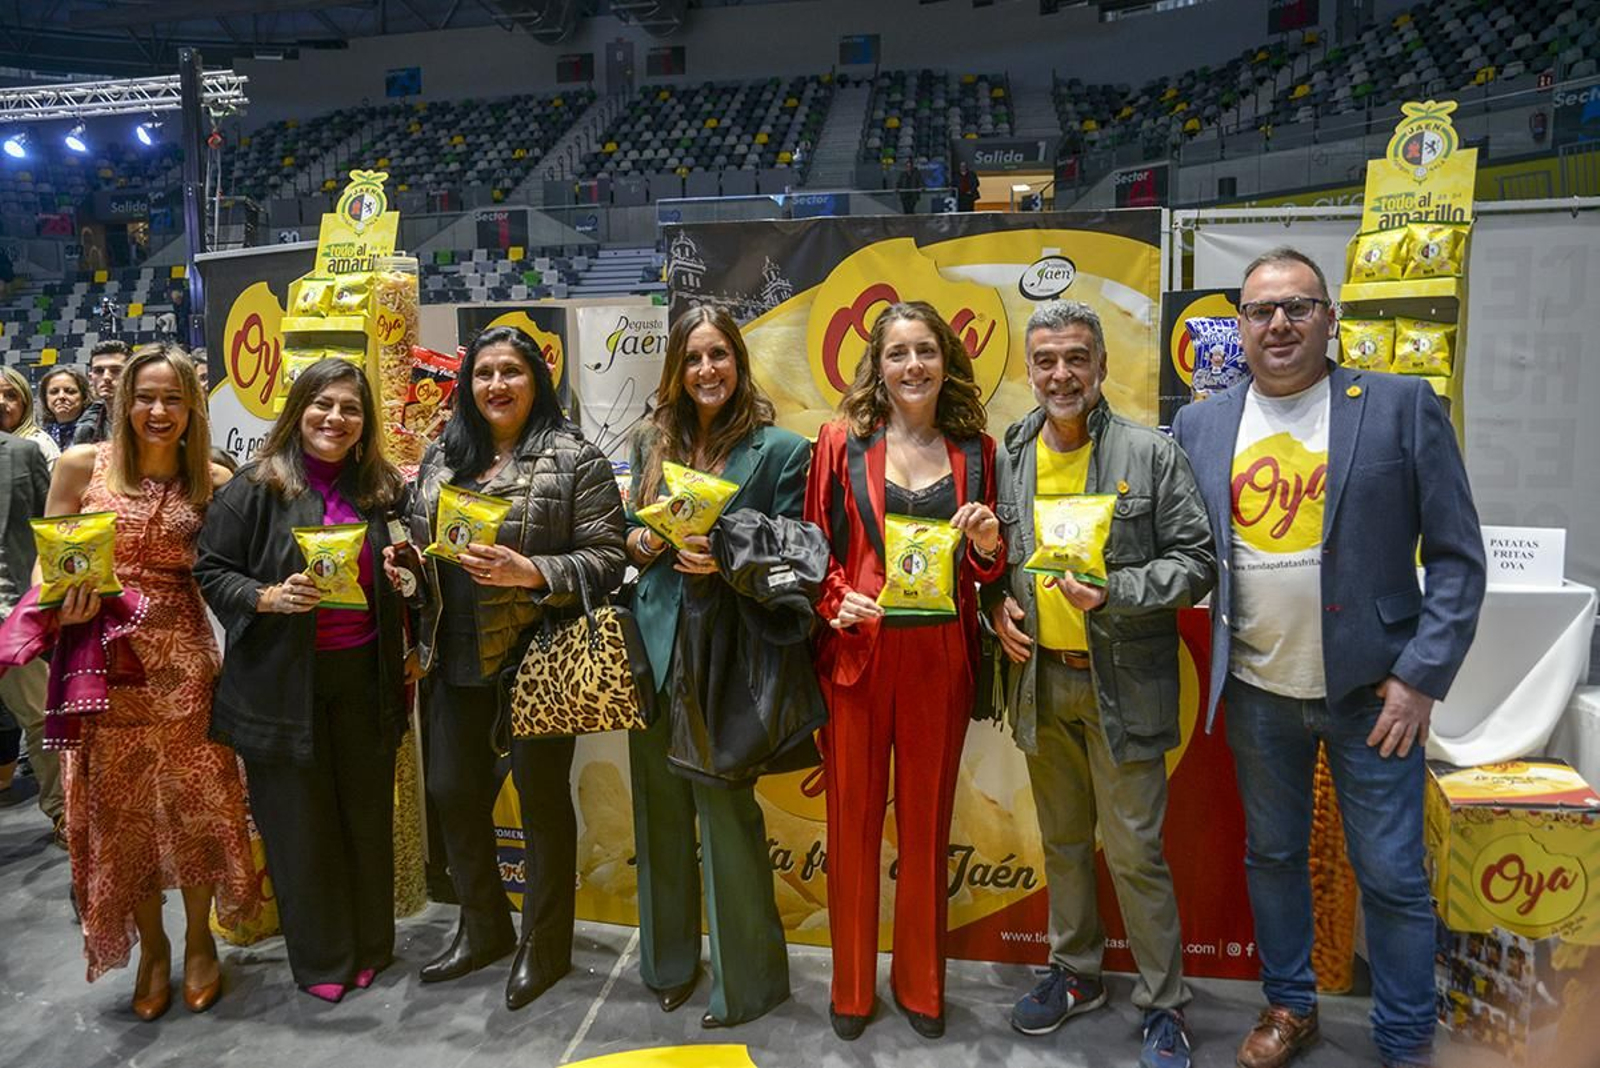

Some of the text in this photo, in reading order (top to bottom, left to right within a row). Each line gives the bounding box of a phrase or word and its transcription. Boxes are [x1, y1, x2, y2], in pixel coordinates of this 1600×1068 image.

[973, 142, 1046, 164] Salida 1
[1113, 171, 1149, 184] Sector
[110, 199, 147, 214] Salida
[793, 196, 828, 206] Sector
[944, 197, 957, 212] 3
[1032, 193, 1043, 212] 3
[1418, 192, 1431, 207] al
[474, 211, 508, 222] Sector
[1379, 204, 1464, 229] amarillo
[357, 243, 367, 256] al
[376, 313, 404, 341] Oya
[616, 314, 664, 333] Degusta
[231, 312, 281, 405] Oy
[417, 383, 441, 401] Oya
[226, 427, 244, 457] La
[1490, 539, 1539, 548] PATATAS
[1493, 550, 1534, 559] FRITAS
[1500, 561, 1525, 570] OYA
[949, 845, 1037, 897] Jaén
[1481, 853, 1578, 916] Oya
